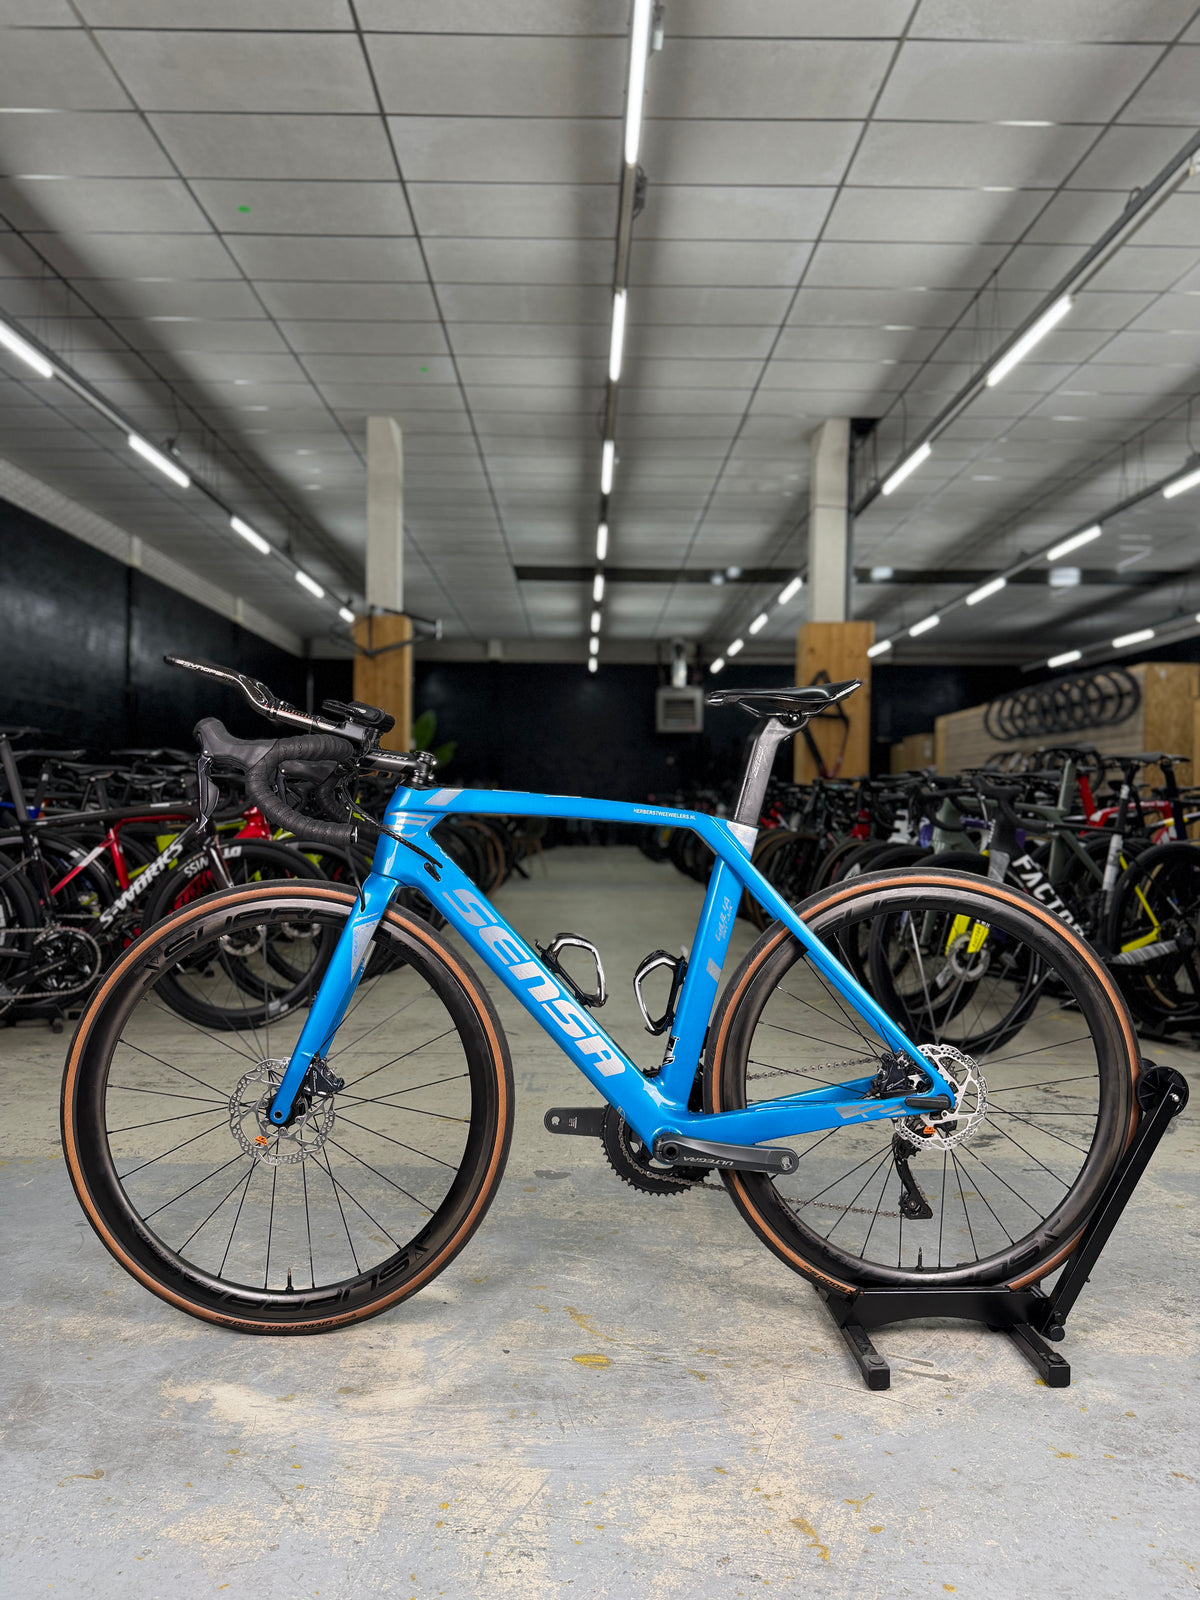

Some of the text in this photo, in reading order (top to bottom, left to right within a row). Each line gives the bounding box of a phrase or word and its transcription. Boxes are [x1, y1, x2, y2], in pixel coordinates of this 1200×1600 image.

[183, 856, 209, 878] WISS
[100, 843, 183, 930] S-WORKS
[442, 888, 626, 1078] SENSA
[683, 1156, 734, 1166] ULTEGRA
[266, 1323, 295, 1331] PRIX
